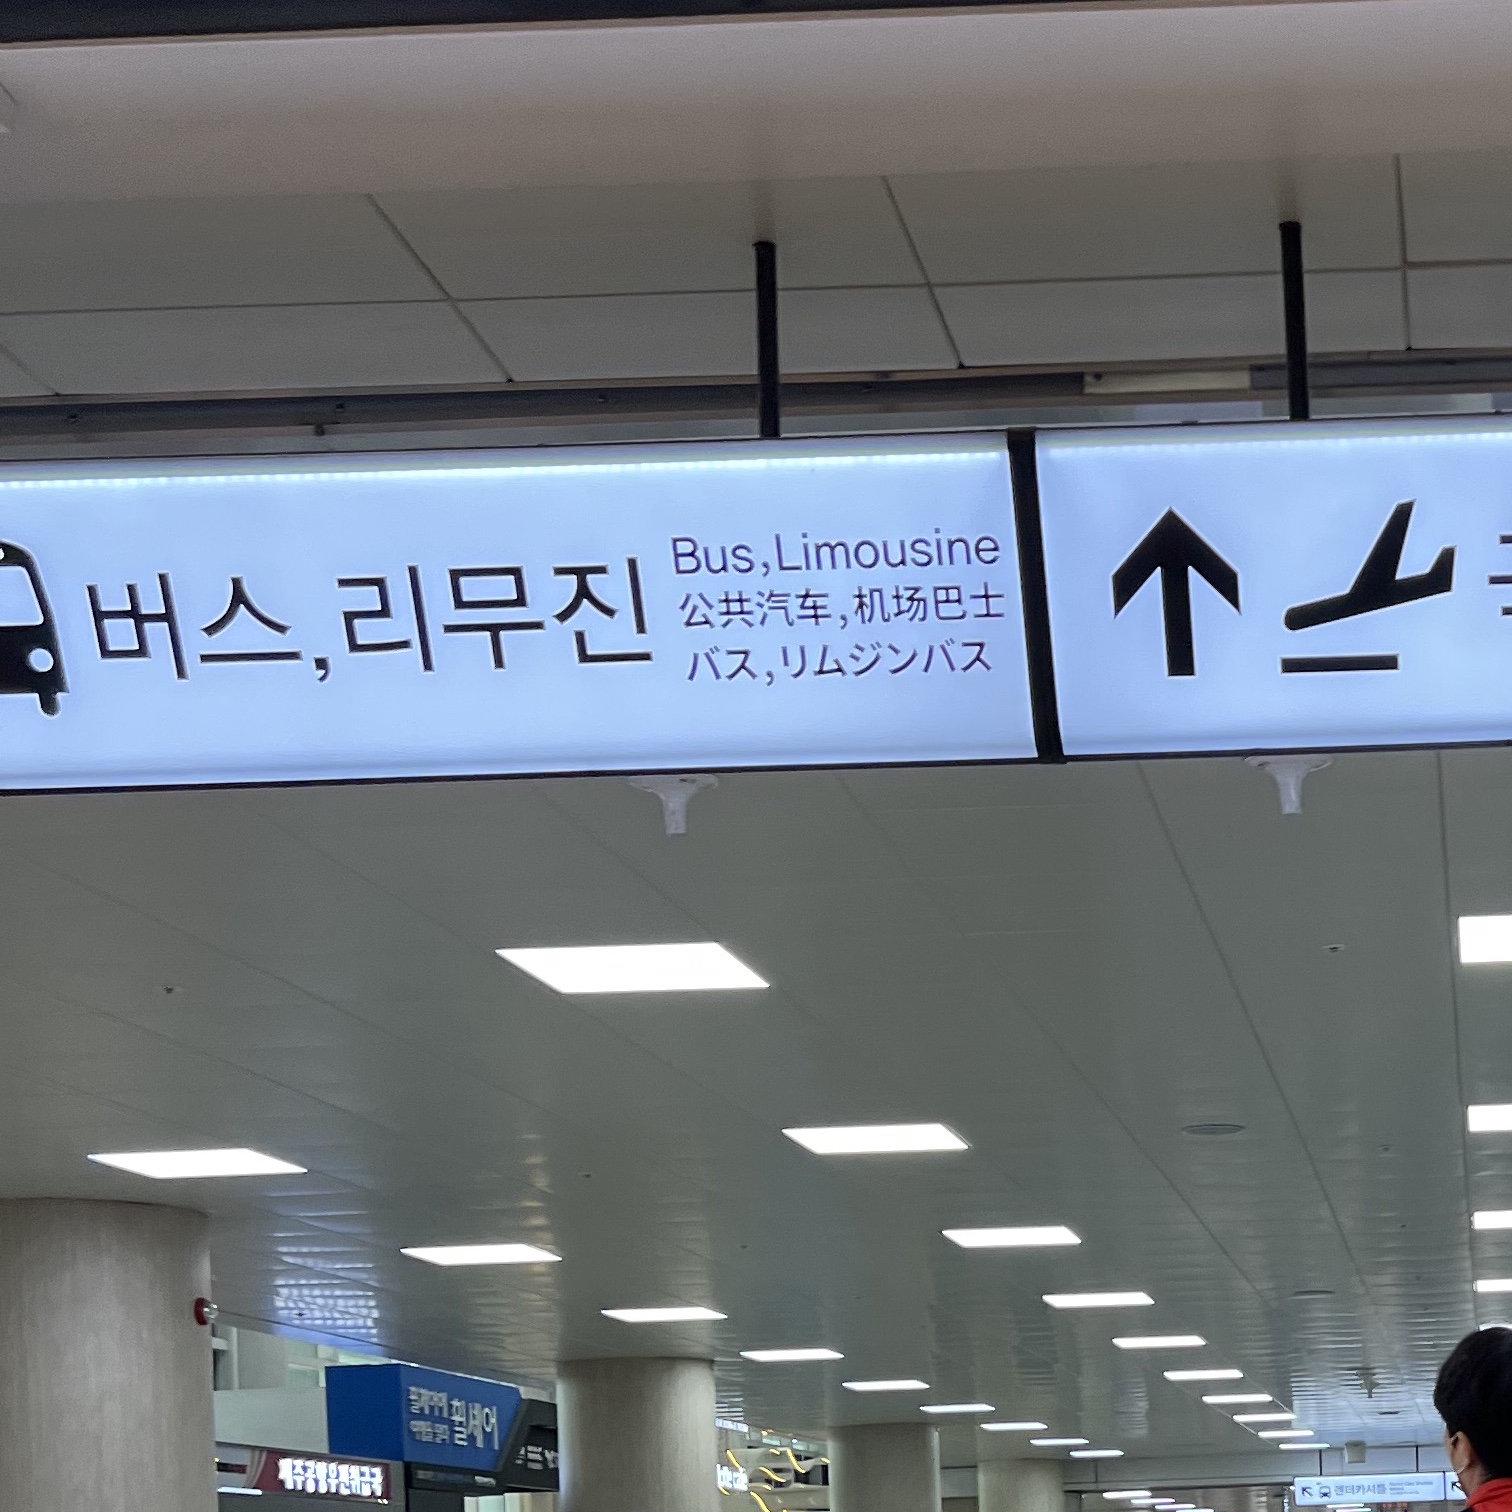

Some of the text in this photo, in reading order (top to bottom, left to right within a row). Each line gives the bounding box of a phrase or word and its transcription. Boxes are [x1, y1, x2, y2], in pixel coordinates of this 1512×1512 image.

[671, 527, 1001, 578] Bus,Limousine
[85, 555, 655, 684] 버스,리무진
[678, 581, 1005, 630] 公共汽车,机场巴士
[686, 637, 993, 687] バス,リムジンバス
